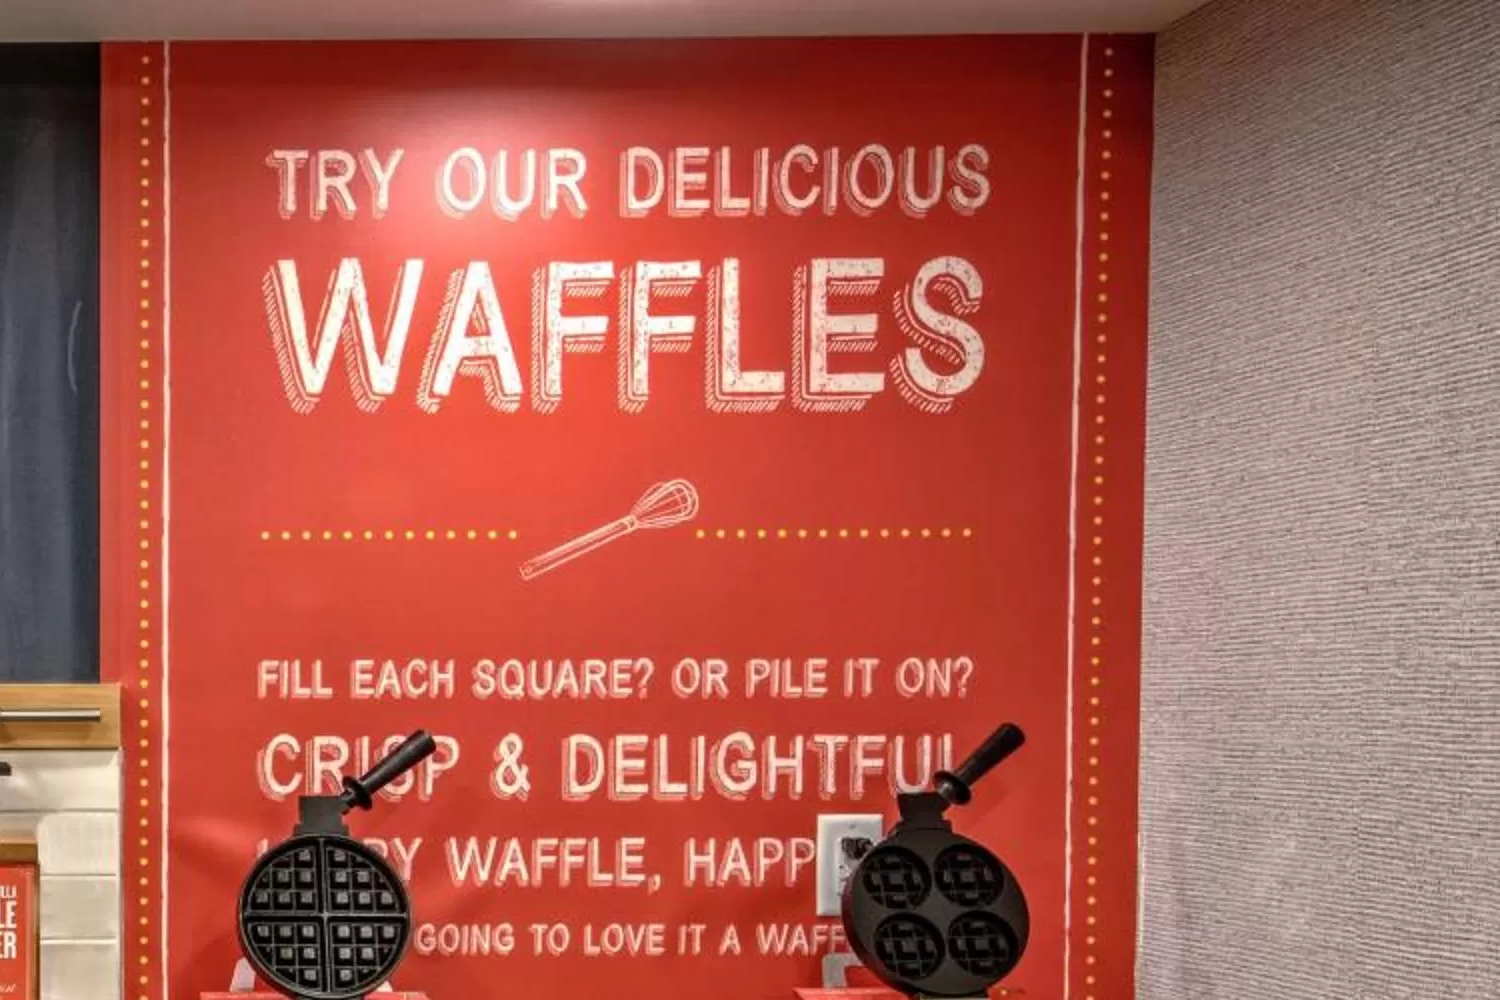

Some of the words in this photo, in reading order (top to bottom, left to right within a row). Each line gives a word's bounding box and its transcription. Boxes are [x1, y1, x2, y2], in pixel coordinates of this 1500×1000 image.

[265, 148, 404, 221] TRY
[436, 147, 588, 222] OUR
[619, 144, 991, 219] DELICIOUS
[261, 256, 984, 415] WAFFLES
[258, 659, 333, 698] FILL
[350, 659, 455, 699] EACH
[471, 657, 654, 703] SQUARE?
[672, 657, 729, 697] OR
[745, 658, 829, 698] PILE
[844, 658, 879, 698] IT
[895, 656, 974, 698] ON?
[492, 733, 531, 801] &
[445, 836, 662, 891] WAFFLE,
[684, 836, 816, 888] HAPP
[414, 922, 515, 956] GOING
[530, 922, 570, 956] TO
[584, 923, 666, 956] LOVE
[678, 923, 707, 955] IT
[719, 923, 741, 956] A
[756, 923, 847, 957] WAFF
